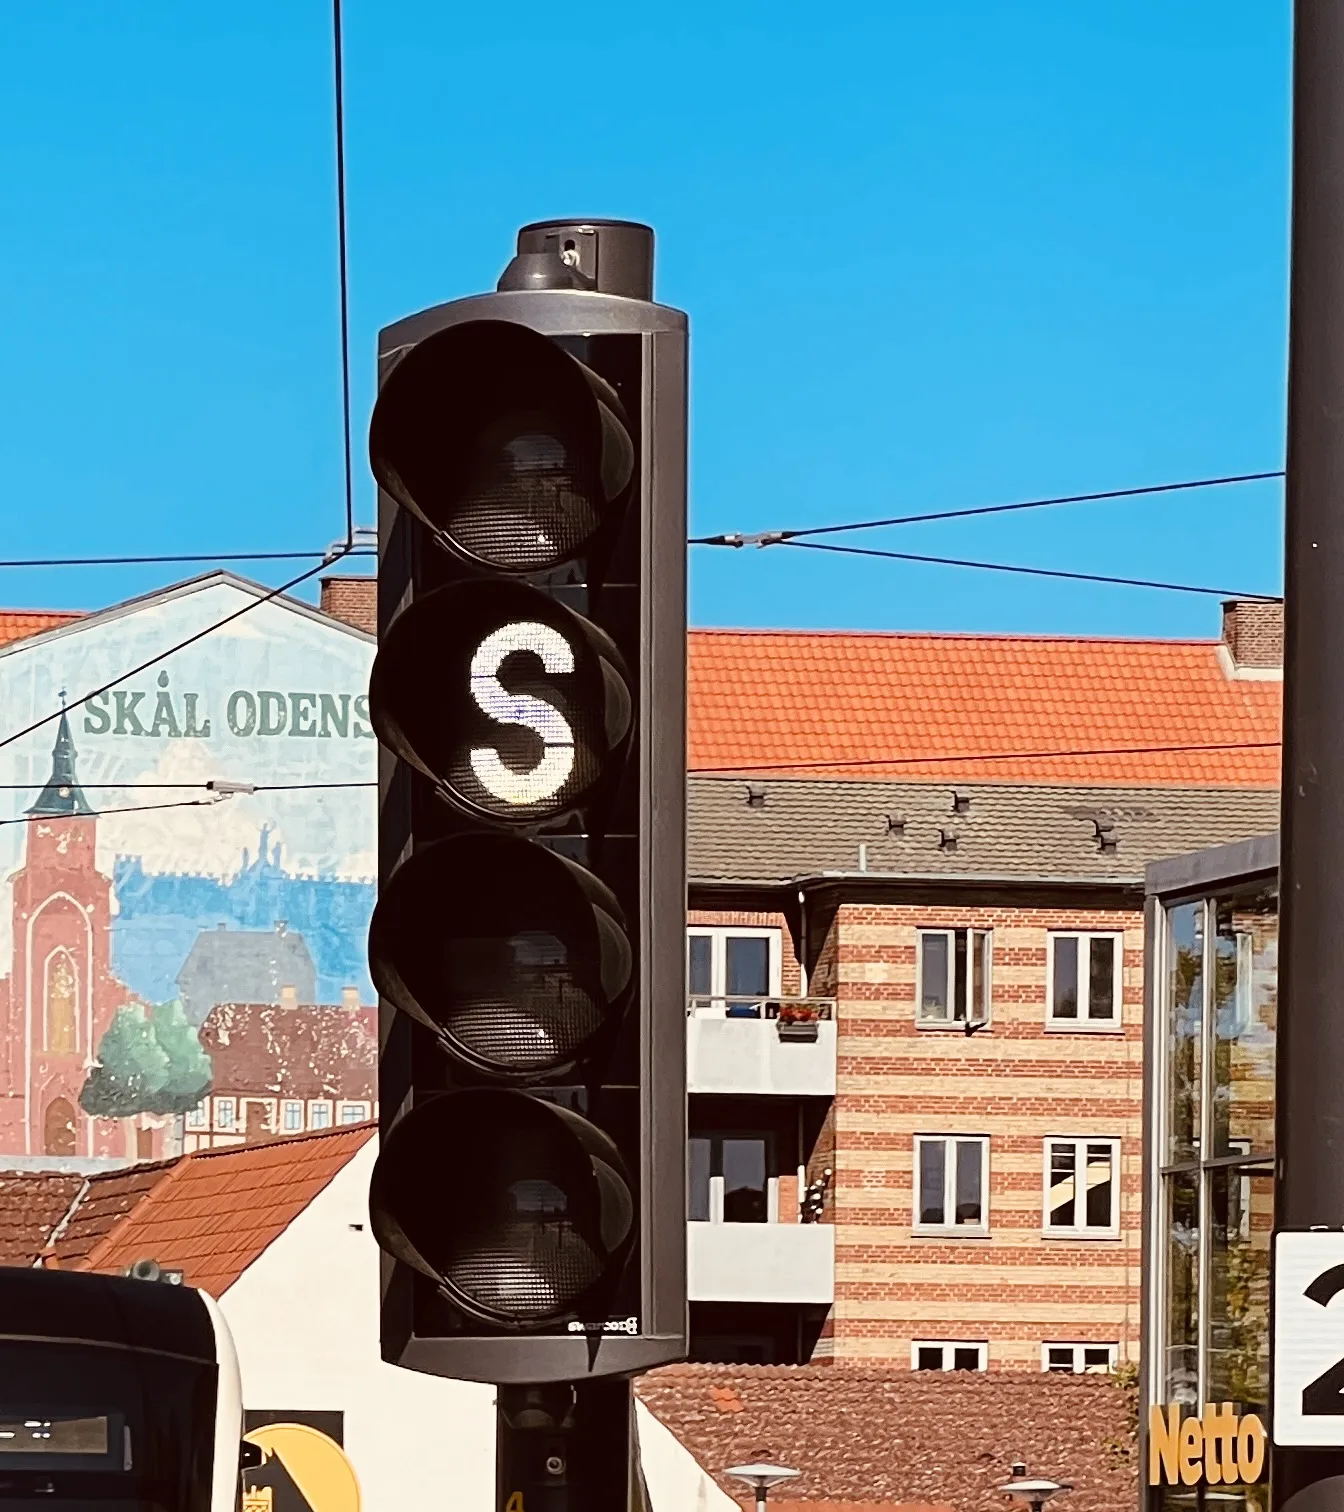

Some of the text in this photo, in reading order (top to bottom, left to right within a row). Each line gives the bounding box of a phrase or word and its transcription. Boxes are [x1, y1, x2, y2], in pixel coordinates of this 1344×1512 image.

[84, 672, 211, 738] SKÅL
[471, 622, 574, 805] S
[1149, 1402, 1265, 1486] Netto
